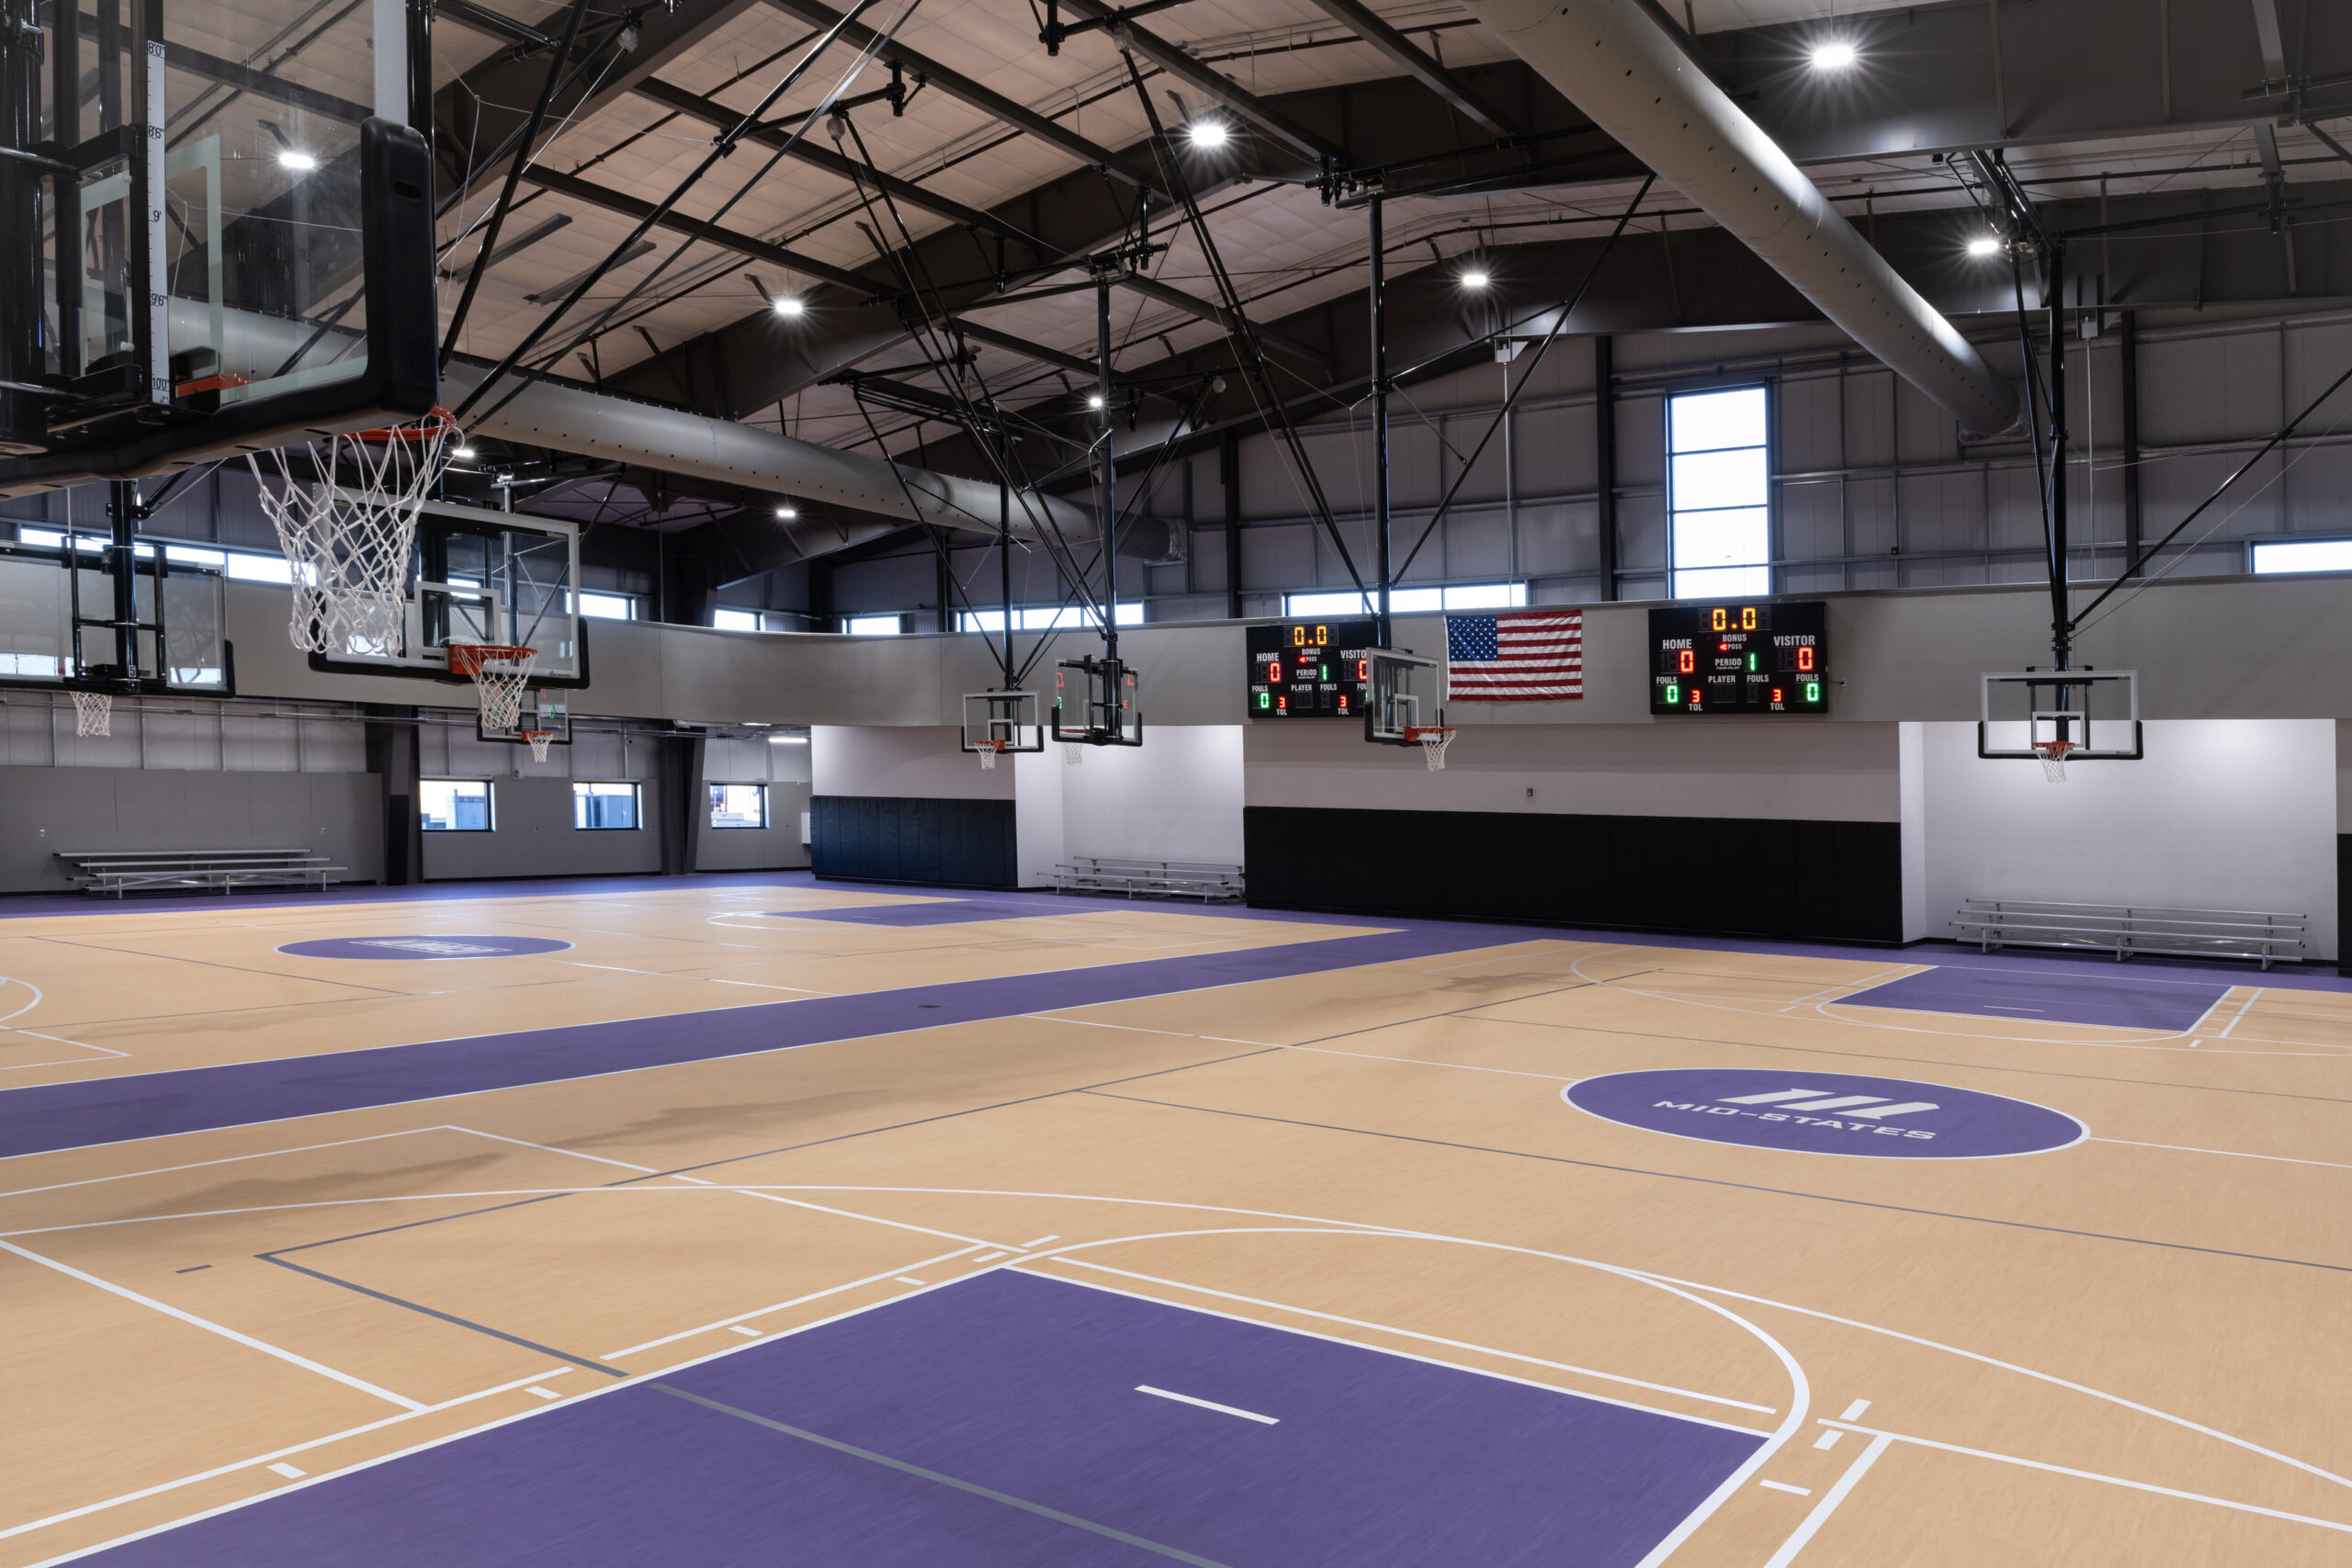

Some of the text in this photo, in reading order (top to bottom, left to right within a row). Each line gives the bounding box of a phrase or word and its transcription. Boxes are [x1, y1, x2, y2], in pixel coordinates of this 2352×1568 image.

[153, 209, 162, 222] 9'
[1662, 638, 1692, 649] HOME
[1722, 634, 1747, 642] BONUS
[1773, 635, 1815, 647] VISITOR
[1256, 652, 1279, 661] HOME
[1340, 649, 1366, 659] VISITO
[1799, 648, 1813, 671] 0
[1680, 650, 1693, 672] 0
[1714, 658, 1742, 667] PERIOD
[130, 666, 136, 677] 5
[1270, 662, 1281, 682] 0
[1795, 673, 1819, 682] FOULS
[1656, 676, 1678, 684] FOULS
[1708, 675, 1736, 683] PLAYER
[1747, 674, 1770, 682] FOULS
[1667, 685, 1679, 703] 0
[1691, 690, 1701, 704] 3
[1773, 689, 1782, 703] 3
[1807, 682, 1819, 702] 0
[1261, 693, 1270, 708] 0
[1279, 696, 1285, 708] 3
[1340, 695, 1347, 707] 3
[1770, 703, 1785, 711] TOL
[1653, 1100, 1937, 1140] MID-STATES
